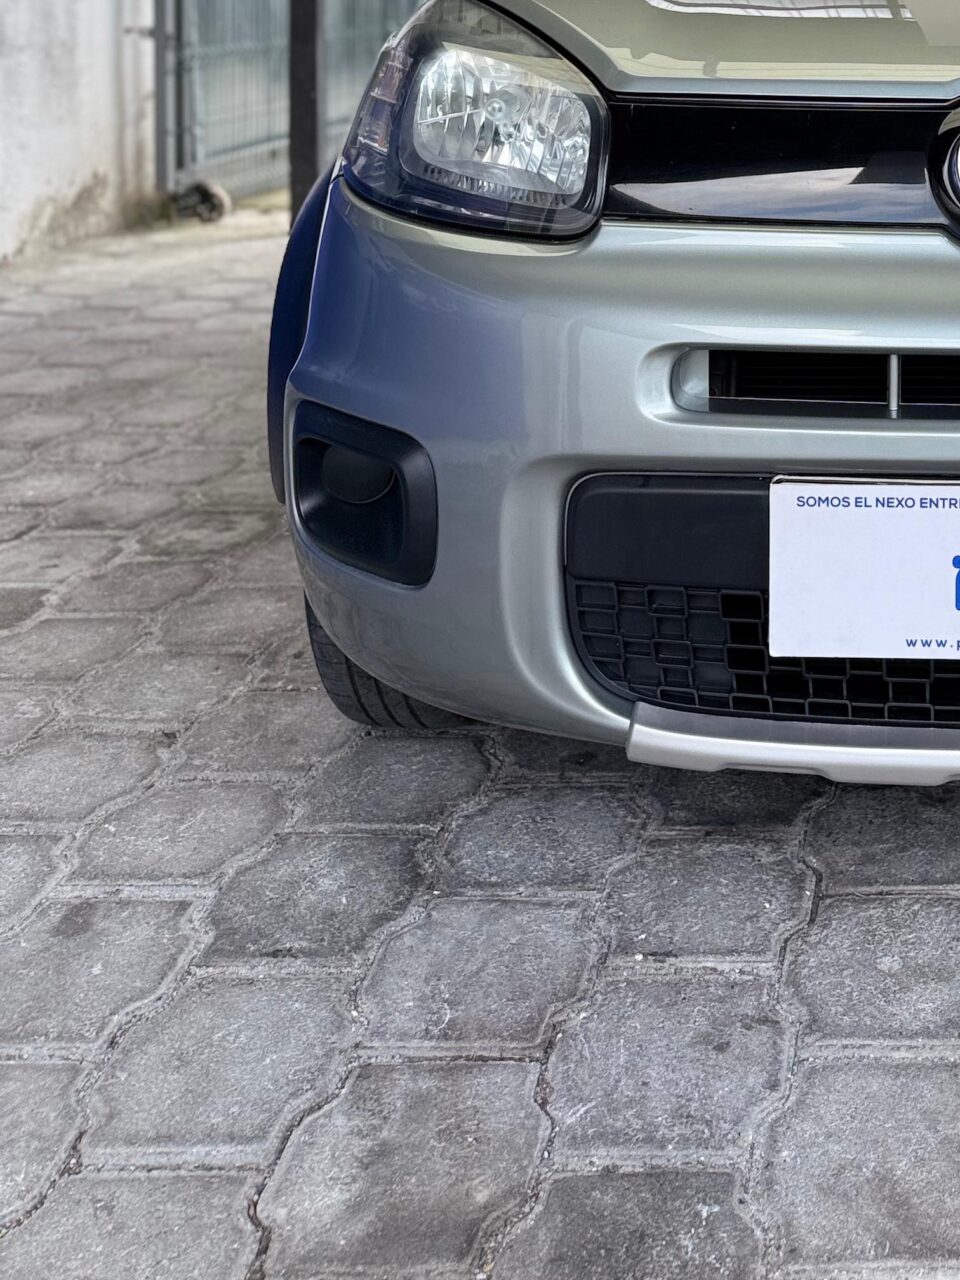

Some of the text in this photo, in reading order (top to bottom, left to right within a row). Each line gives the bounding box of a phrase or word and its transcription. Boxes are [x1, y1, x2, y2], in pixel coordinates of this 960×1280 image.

[796, 495, 851, 508] SOMOS
[854, 496, 872, 508] EL
[875, 496, 916, 509] NEXO
